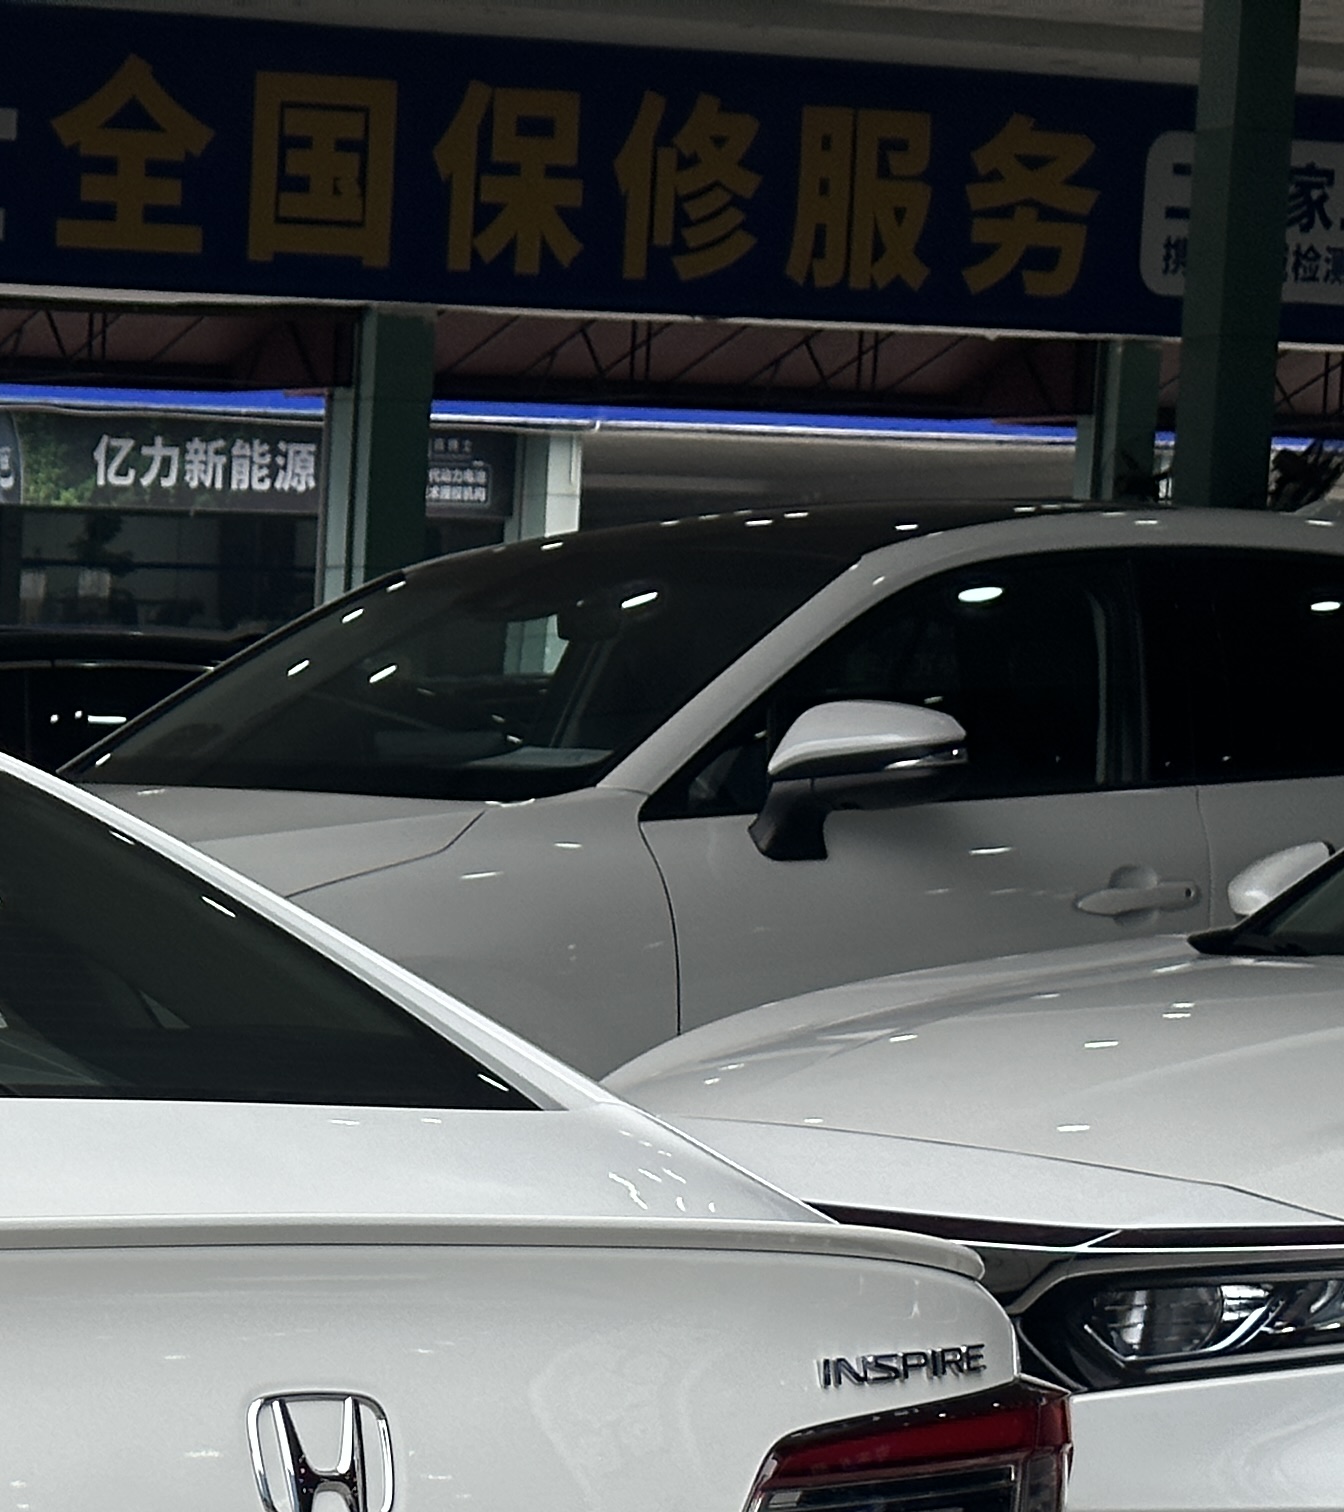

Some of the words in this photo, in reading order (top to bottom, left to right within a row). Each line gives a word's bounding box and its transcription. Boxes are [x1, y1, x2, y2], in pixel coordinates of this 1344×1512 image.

[92, 434, 317, 494] 亿力新能源
[816, 1343, 986, 1389] INSPIRE
